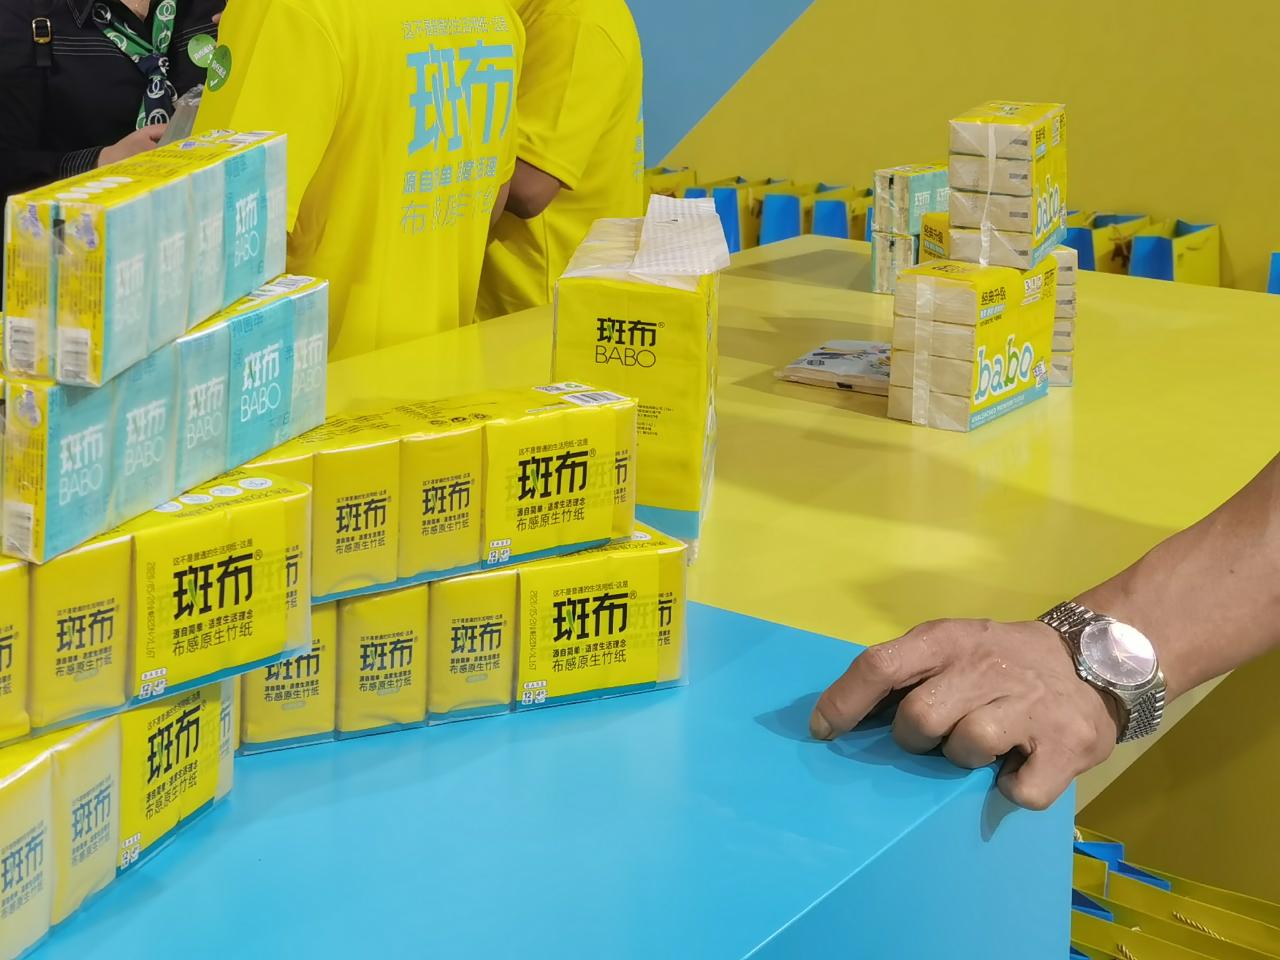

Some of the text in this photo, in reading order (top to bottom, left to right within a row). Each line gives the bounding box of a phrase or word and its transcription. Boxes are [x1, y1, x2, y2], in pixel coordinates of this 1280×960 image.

[406, 40, 513, 156] 斑布
[236, 191, 259, 237] 斑布
[596, 317, 657, 347] 斑布
[242, 342, 280, 392] 斑布
[595, 345, 657, 368] BABO
[974, 334, 1034, 405] babo
[187, 377, 225, 422] 斑布
[240, 383, 281, 422] BABO
[126, 399, 166, 443] 斑布
[59, 423, 104, 474] 斑布
[125, 437, 165, 477] BABO
[59, 464, 103, 506] BABO
[517, 451, 588, 501] 斑布
[336, 498, 387, 534] 斑布
[422, 481, 470, 516] 斑布
[516, 507, 585, 532] 布感原生竹纸
[173, 552, 254, 621] 斑布
[56, 607, 115, 652] 斑布
[450, 621, 503, 654] 斑布
[552, 592, 629, 643] 斑布
[172, 620, 253, 657] 布感原生竹纸
[360, 638, 414, 672] 斑布
[55, 655, 112, 678] 布感原生竹纸
[449, 660, 501, 675] 布感原生竹纸
[552, 649, 627, 673] 布感原生竹纸
[264, 686, 319, 703] 布感原生竹纸
[359, 678, 412, 692] 布感原生竹纸
[147, 705, 201, 784] 斑布
[71, 784, 111, 843] 斑布
[1, 830, 44, 894] 斑布
